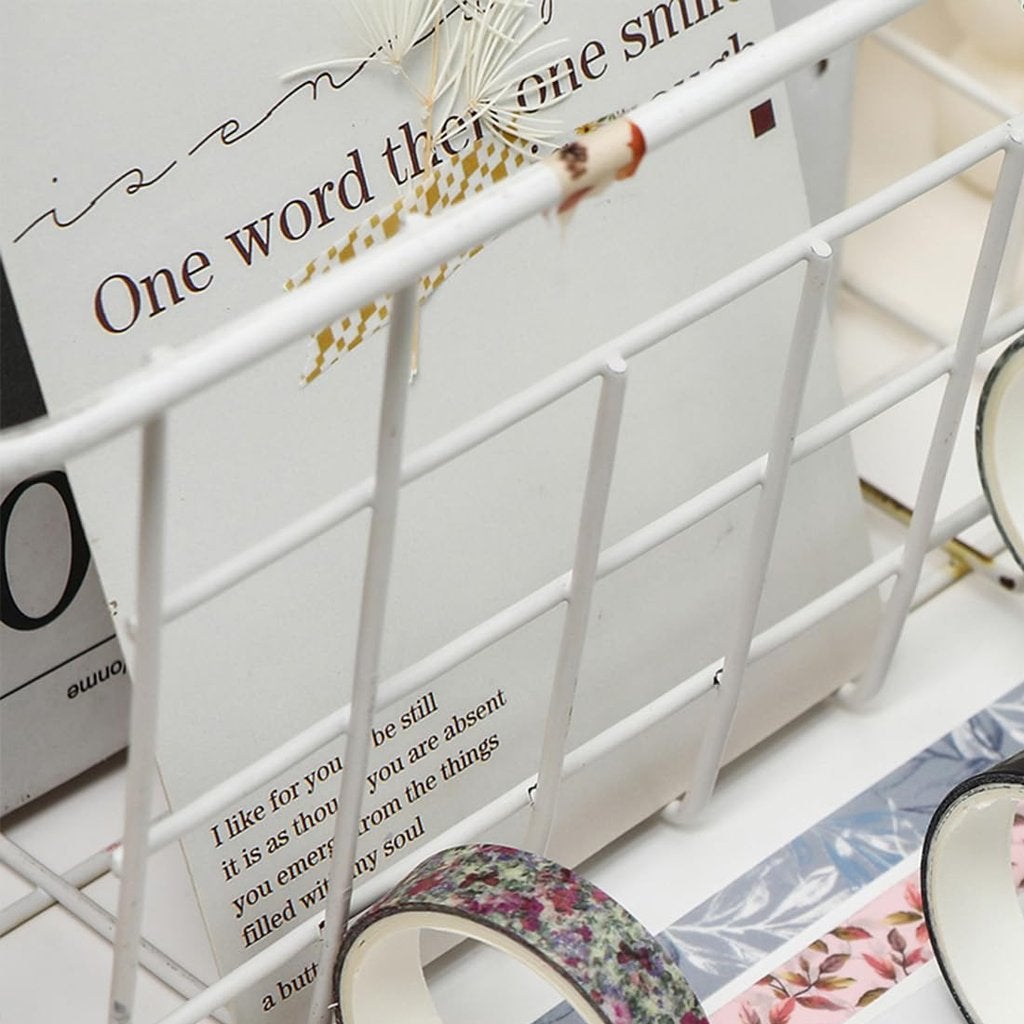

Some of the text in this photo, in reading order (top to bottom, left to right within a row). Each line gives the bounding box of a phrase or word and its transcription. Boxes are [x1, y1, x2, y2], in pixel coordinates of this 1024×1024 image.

[93, 250, 214, 335] One
[225, 149, 375, 267] word
[516, 38, 609, 114] one
[209, 692, 439, 849] I like for you be still
[221, 688, 509, 882] it is as thou you are absent
[231, 880, 273, 919] you
[357, 797, 403, 837] rom
[405, 773, 438, 805] the
[439, 732, 502, 783] things
[240, 904, 297, 949] filled
[299, 880, 331, 910] wit
[383, 815, 427, 858] soul
[261, 995, 276, 1013] a
